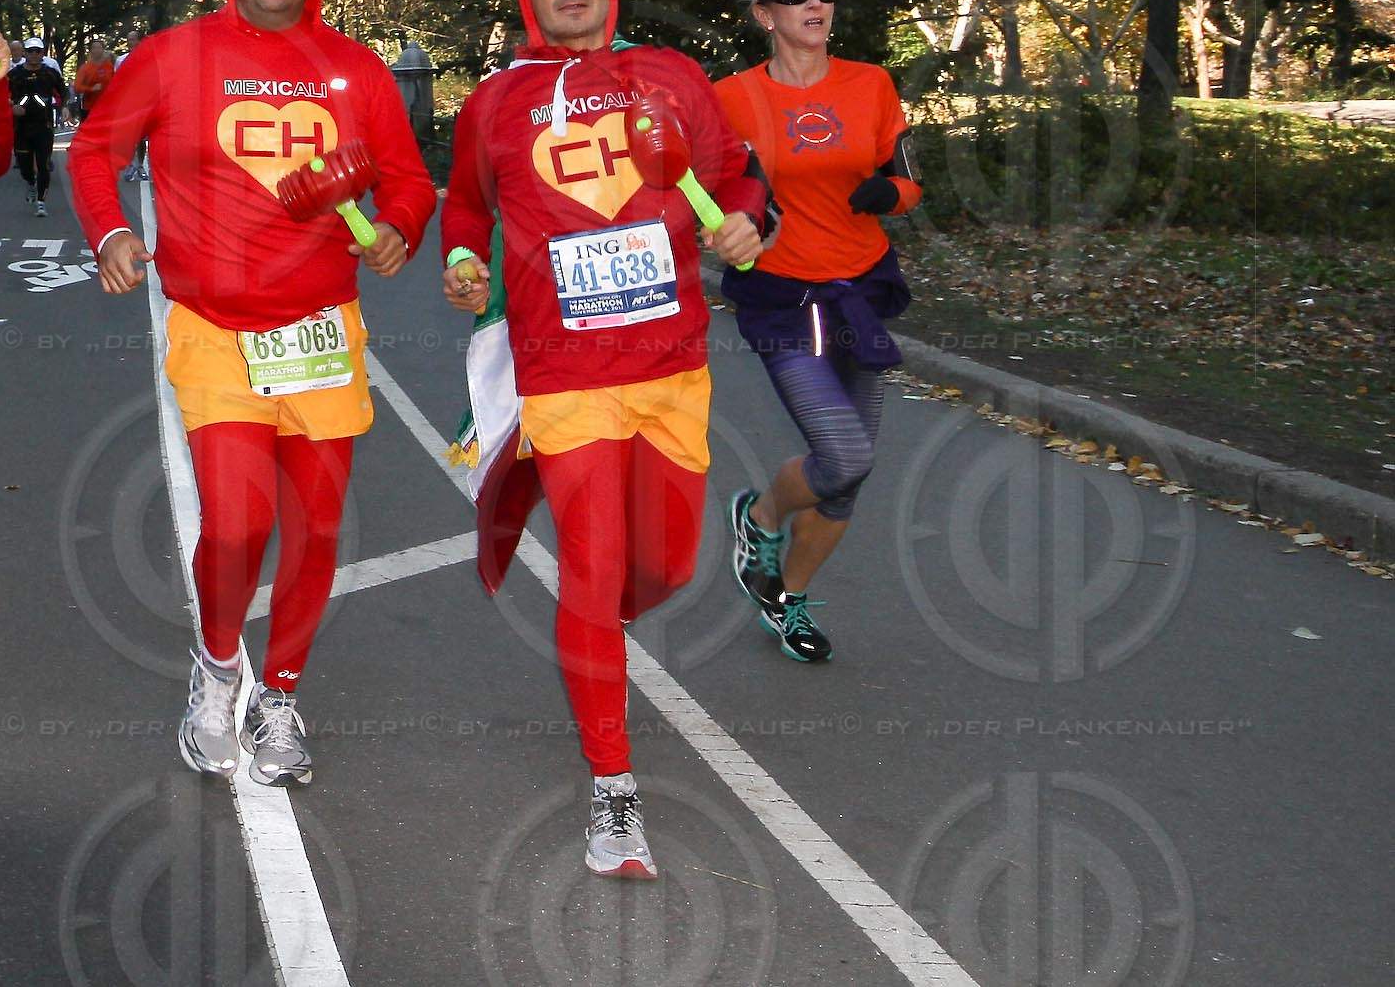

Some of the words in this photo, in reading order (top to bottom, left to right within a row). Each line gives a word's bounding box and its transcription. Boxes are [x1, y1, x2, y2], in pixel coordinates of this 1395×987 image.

[223, 79, 328, 99] MEXICALI
[530, 90, 641, 125] MXICALI
[235, 120, 324, 158] CH
[575, 239, 620, 259] ING
[571, 250, 659, 293] 41-638
[569, 298, 623, 312] MARATHON
[253, 320, 340, 360] 68-069
